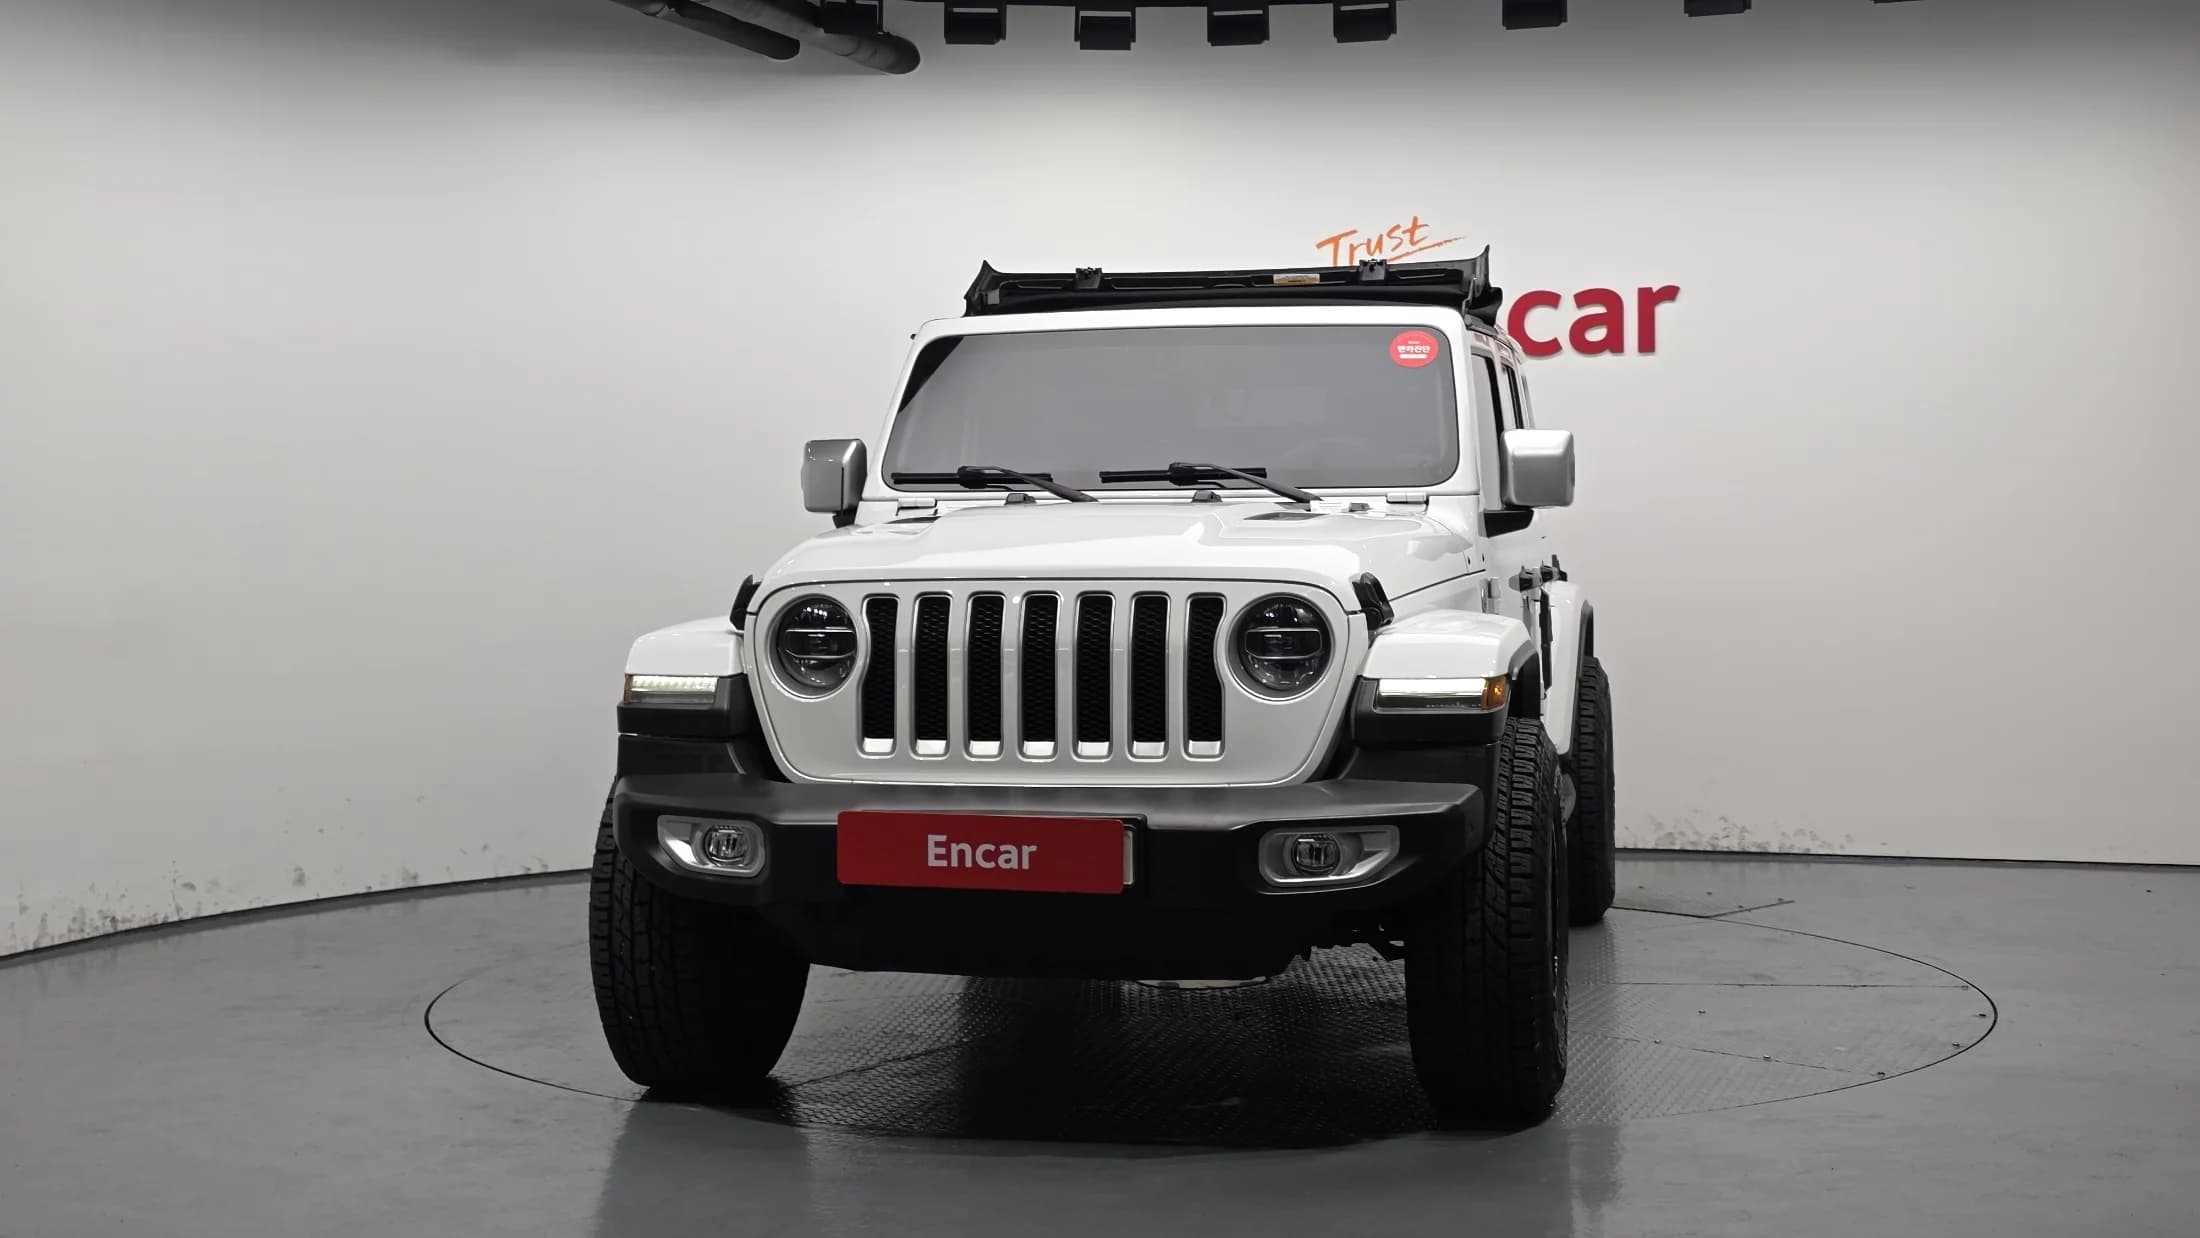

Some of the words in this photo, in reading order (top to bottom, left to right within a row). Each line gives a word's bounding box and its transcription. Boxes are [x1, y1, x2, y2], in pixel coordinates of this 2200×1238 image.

[1316, 215, 1430, 266] Trust
[1507, 284, 1681, 357] car
[927, 834, 1038, 870] Encar
